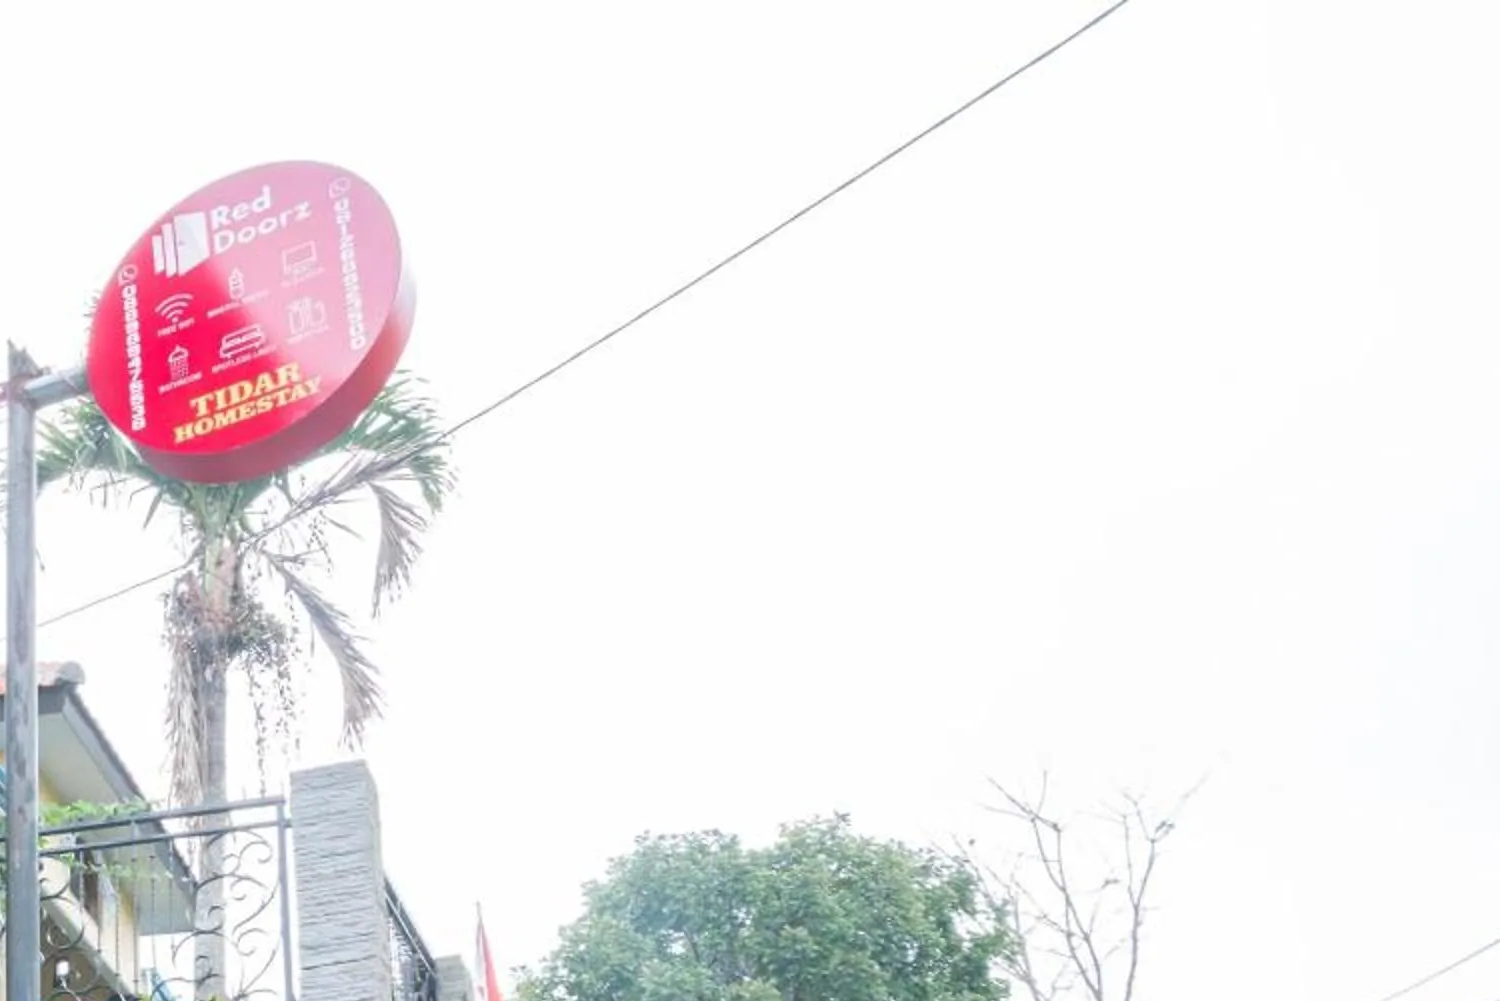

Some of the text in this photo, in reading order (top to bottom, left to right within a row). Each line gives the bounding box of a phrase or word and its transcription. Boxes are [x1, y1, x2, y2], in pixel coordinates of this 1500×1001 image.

[210, 185, 271, 231] Red
[213, 201, 313, 256] Doorz
[173, 374, 322, 444] HOMESTAY
[189, 361, 302, 418] TIDAR
